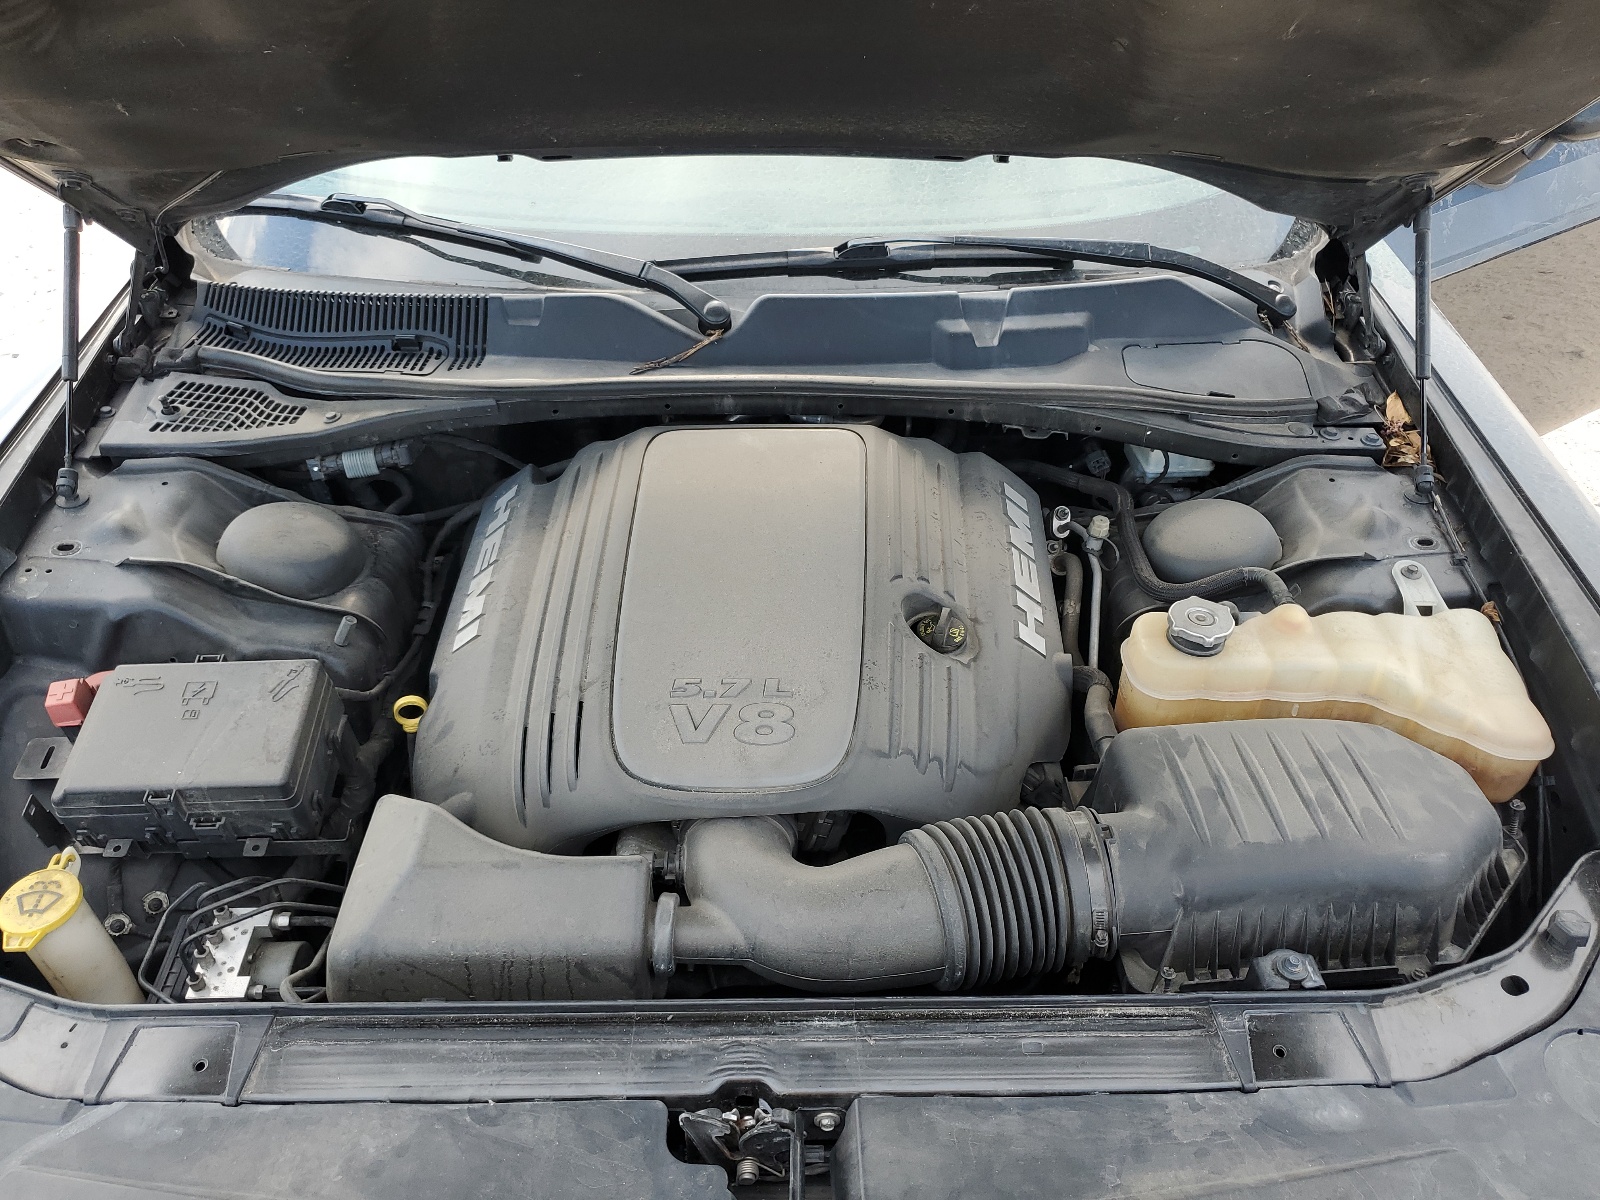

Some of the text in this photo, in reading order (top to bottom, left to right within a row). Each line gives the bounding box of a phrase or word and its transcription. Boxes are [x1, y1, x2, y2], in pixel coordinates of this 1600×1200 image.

[452, 484, 518, 653] HEMI
[1003, 482, 1047, 657] HEMI
[669, 701, 796, 746] V8
[670, 678, 794, 698] 5.7 L
